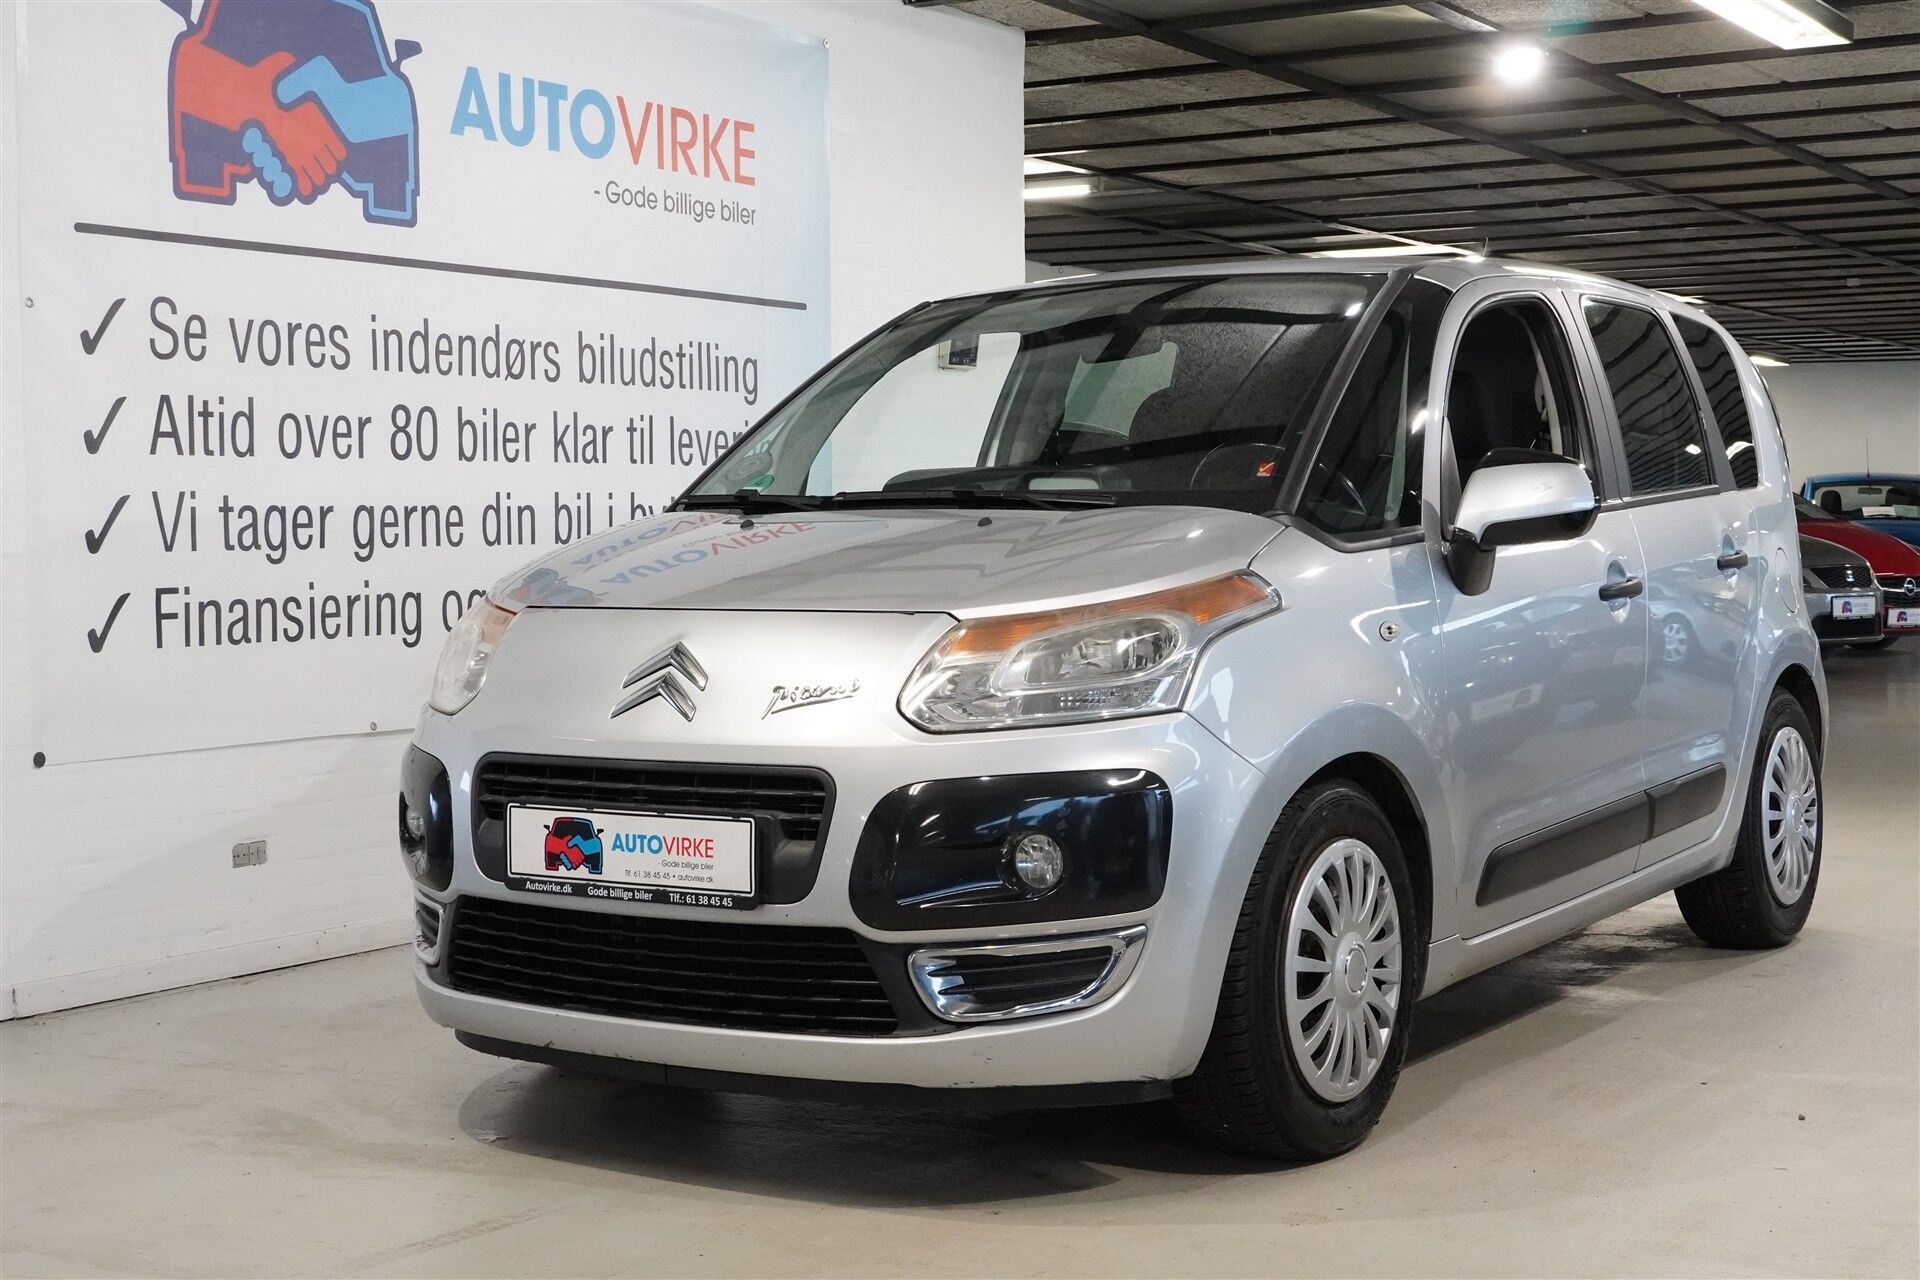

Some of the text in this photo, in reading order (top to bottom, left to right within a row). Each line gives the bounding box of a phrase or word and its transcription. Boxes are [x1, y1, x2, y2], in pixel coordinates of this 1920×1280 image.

[449, 66, 756, 187] AUTOVIRKE
[605, 180, 658, 210] Gode
[663, 189, 715, 223] billige
[720, 199, 756, 226] biler
[149, 297, 758, 406] Se vores indendørs biludstilling
[149, 394, 255, 458] Altid
[278, 404, 372, 460] over
[390, 404, 438, 462] 80
[457, 406, 537, 463] biler
[552, 410, 614, 466] klar
[626, 414, 654, 465] til
[151, 491, 196, 553] Vi
[218, 495, 334, 565] tager
[352, 505, 464, 563] gerne
[482, 491, 536, 547] din
[554, 491, 592, 546] bil
[154, 579, 487, 649] Finansiering o
[611, 833, 714, 858] AUTOVIRKE
[661, 859, 680, 868] Gode
[525, 880, 733, 907] Autovirke.dk Gode billige biler Tlf.: 61 38 45 45
[634, 870, 641, 878] 61
[643, 871, 651, 879] 38
[653, 872, 661, 880] 45
[662, 872, 671, 880] 45
